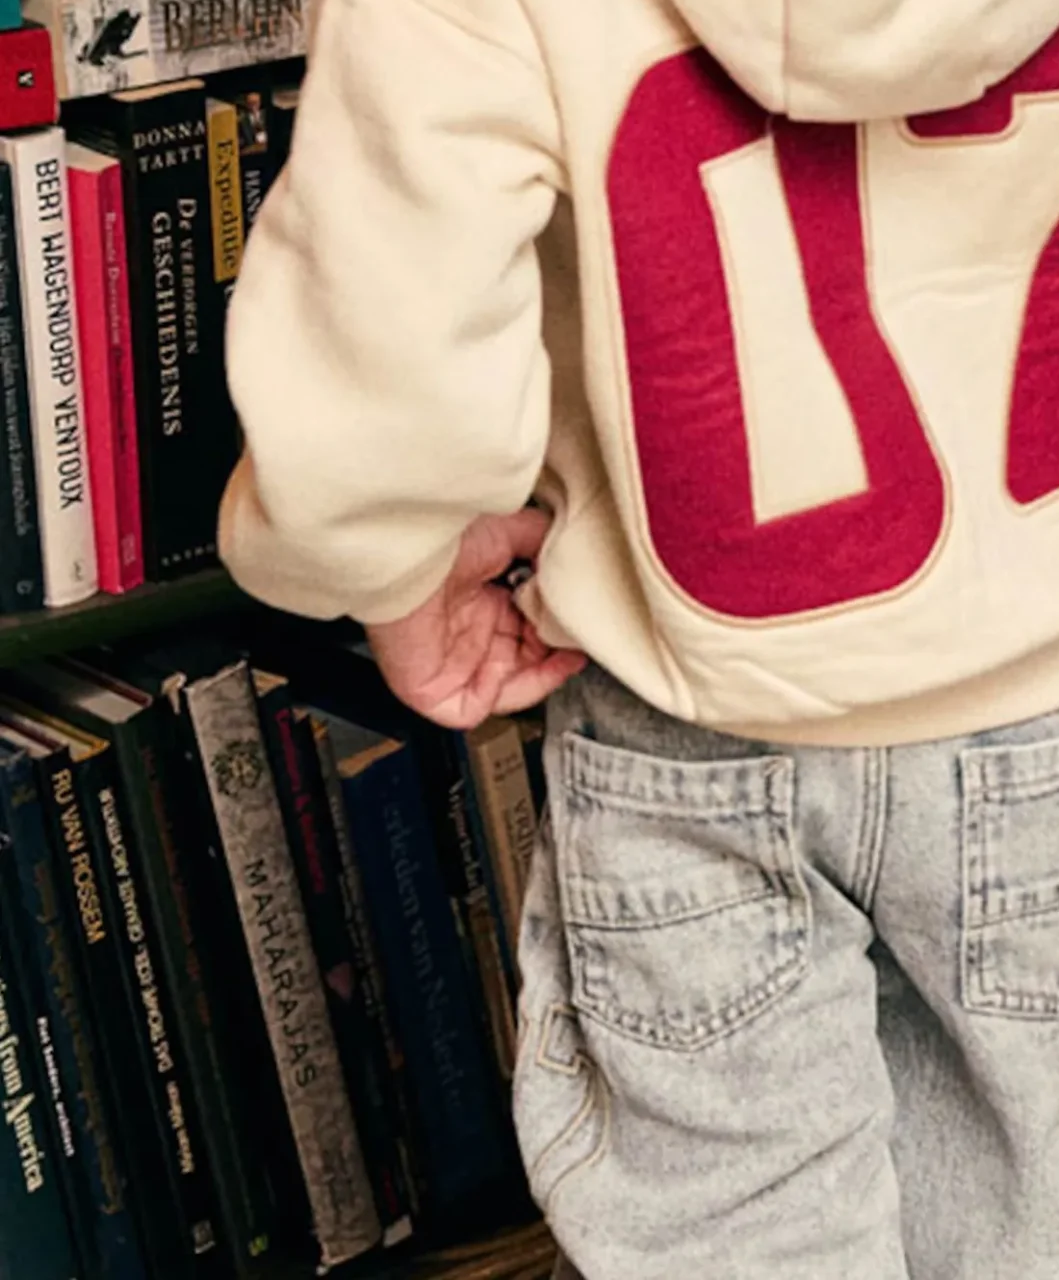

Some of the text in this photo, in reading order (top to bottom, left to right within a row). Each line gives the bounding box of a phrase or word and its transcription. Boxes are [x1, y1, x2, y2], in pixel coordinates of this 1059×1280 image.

[132, 120, 206, 151] DONNA
[138, 142, 206, 173] TARTT
[213, 137, 241, 270] Expeditie
[34, 157, 86, 511] BERT WAGENDORP VENTOUX
[151, 211, 184, 437] GESCHIEDENIS
[177, 197, 200, 356] De VERBORGEN
[51, 767, 108, 945] RU VAN ROSSEM
[243, 858, 318, 1090] MAHARAJAS
[2, 1092, 46, 1194] America
